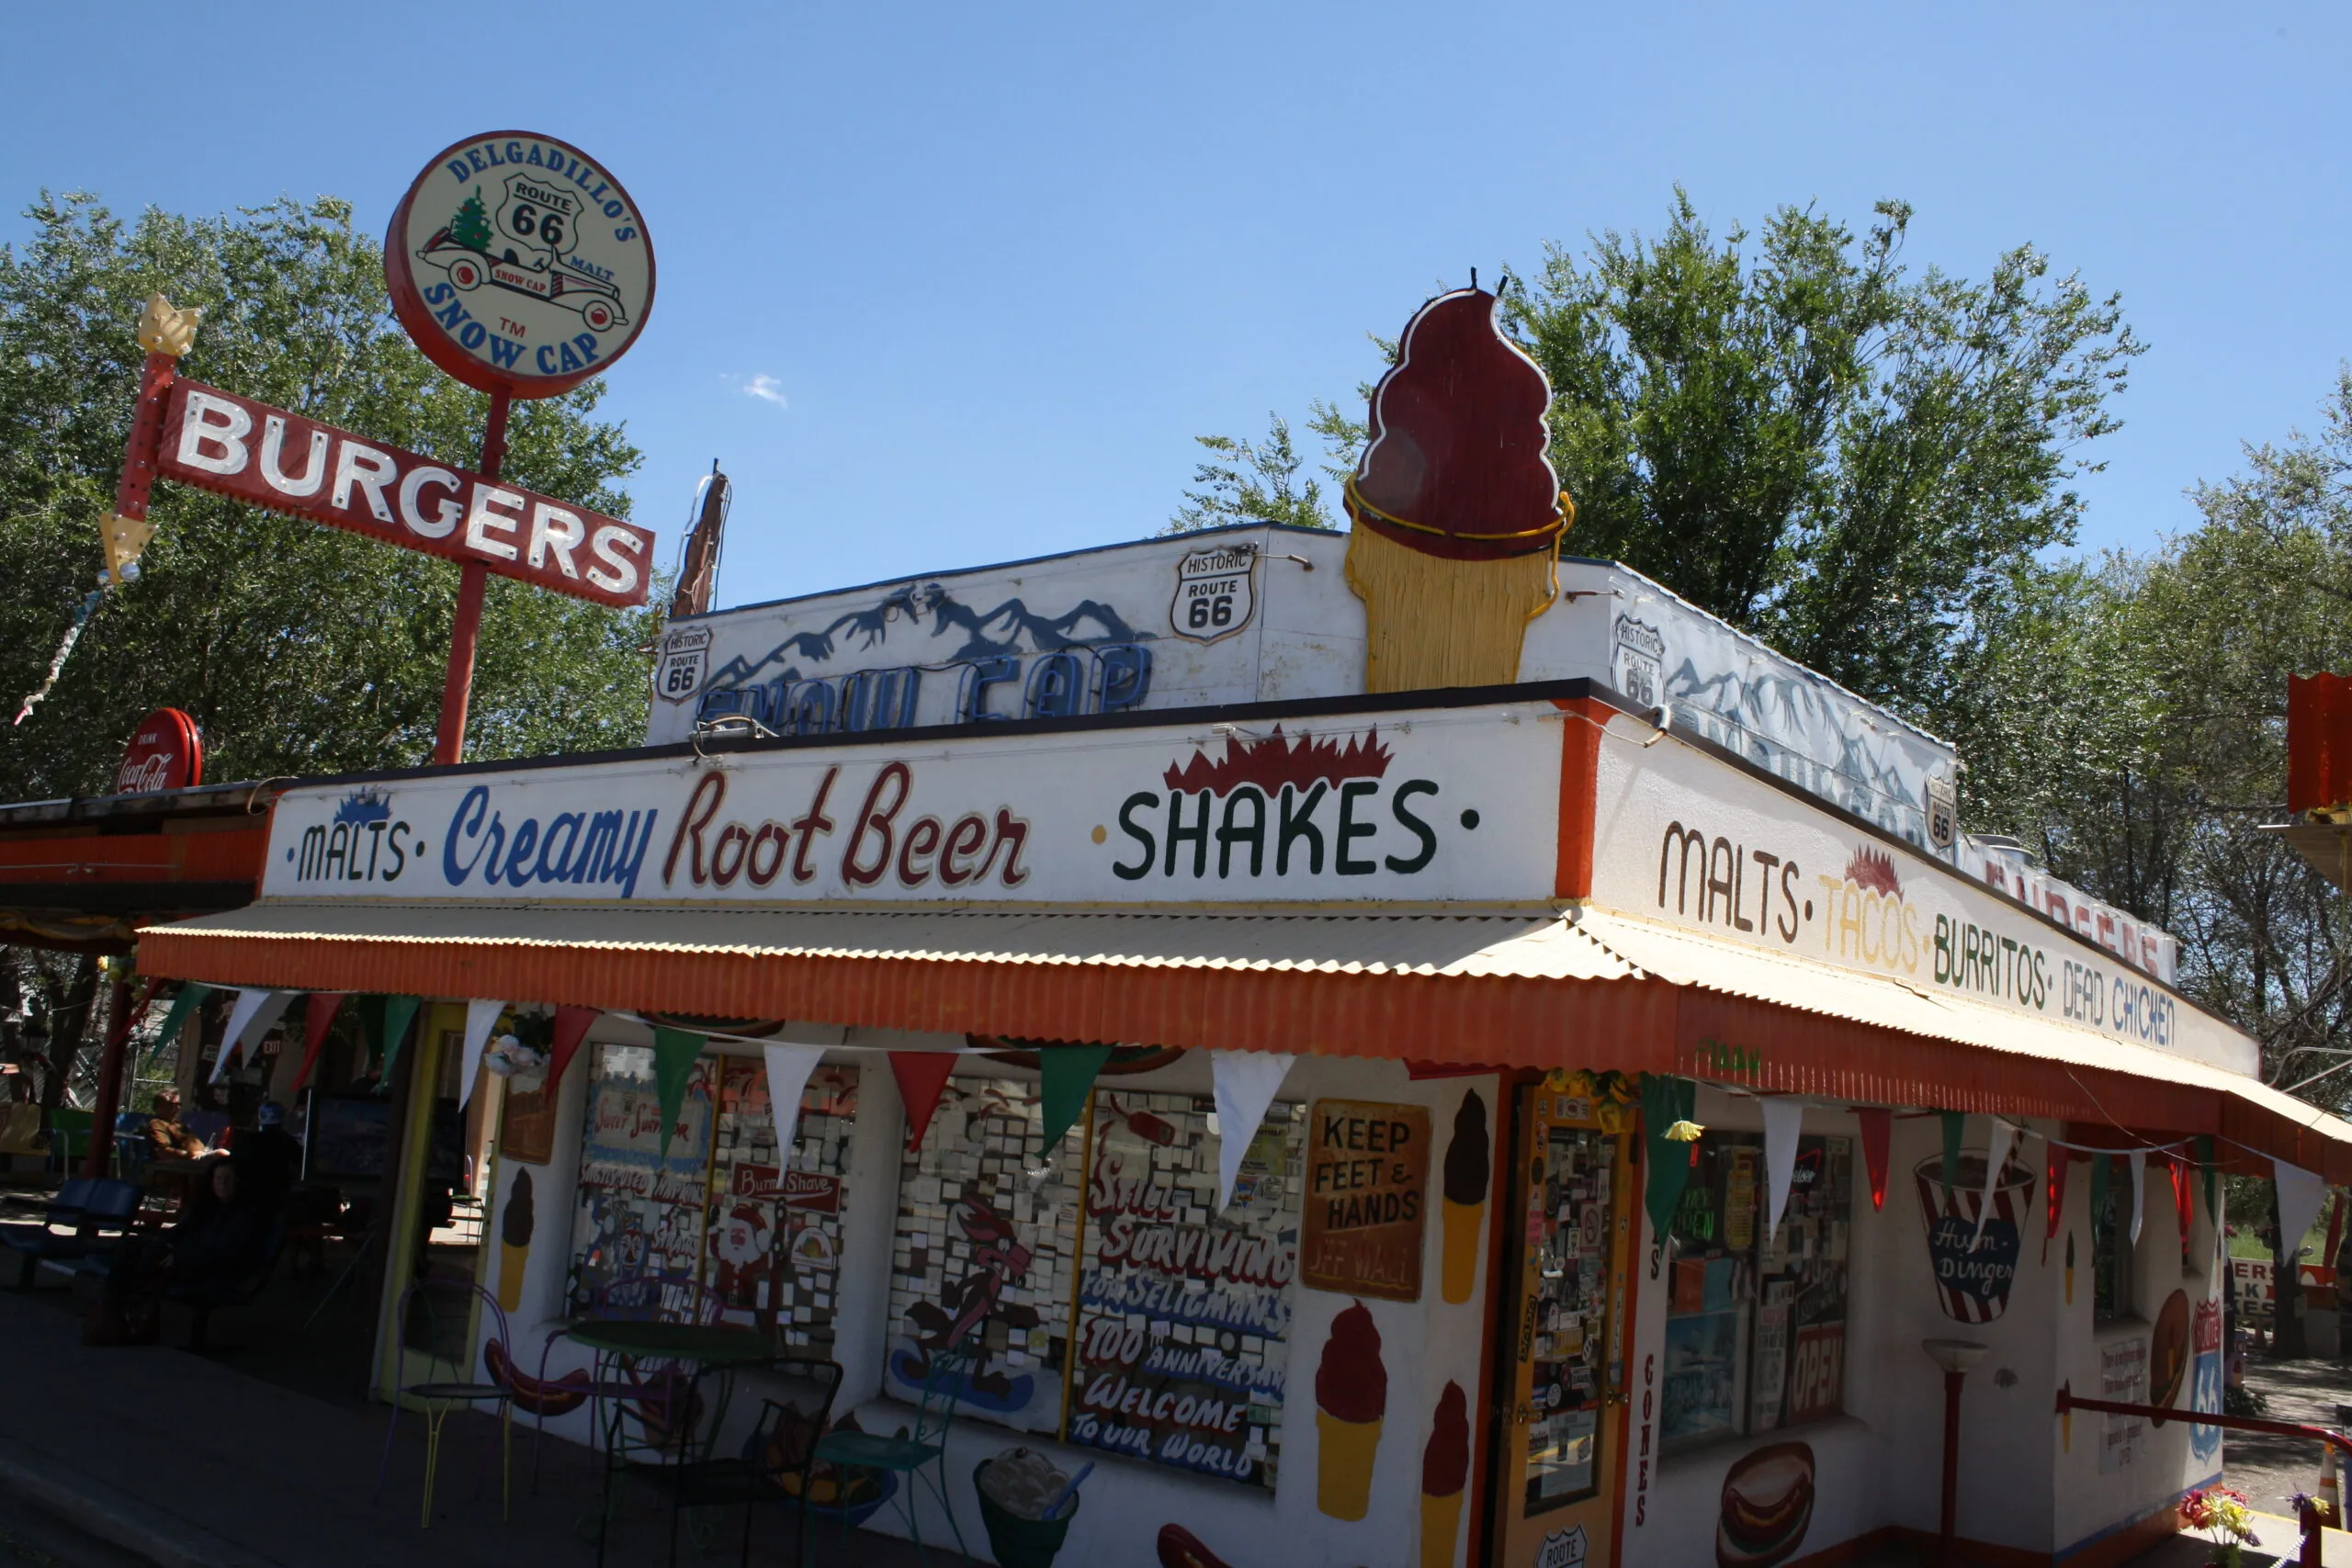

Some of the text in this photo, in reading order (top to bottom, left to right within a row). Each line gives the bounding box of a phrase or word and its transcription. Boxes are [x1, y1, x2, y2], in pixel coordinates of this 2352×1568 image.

[446, 141, 638, 243] DELGADILLO'S
[514, 180, 572, 212] ROUTE
[512, 203, 566, 246] 66
[493, 267, 547, 293] SNOW CAP
[568, 254, 616, 279] MALT
[423, 279, 601, 377] SNOW CAP
[499, 317, 526, 339] TM
[175, 389, 645, 595] BURGERS
[1186, 551, 1248, 576] HISTORIC
[1187, 580, 1238, 599] ROUTE
[1188, 597, 1233, 629] 66
[669, 632, 708, 651] HISTORIC
[1620, 623, 1659, 652] HISTORIC
[667, 665, 695, 692] 66
[669, 653, 701, 669] ROUTE
[1623, 651, 1655, 677] ROUTE
[954, 642, 1154, 724] CAP
[1625, 669, 1655, 707] 66
[297, 759, 1442, 899] MALTS Creamy Root Beer SHAKES
[1933, 813, 1950, 841] 66
[1657, 819, 2177, 1047] MALTS TACOS BURRITOS DEAD CHICKEN
[1323, 1114, 1411, 1154] KEEP
[1314, 1157, 1385, 1193] FEET
[1391, 1162, 1414, 1184] &
[1327, 1190, 1420, 1230] HANDS
[1099, 1218, 1296, 1290] SURVIVING
[1079, 1268, 1125, 1306] FOR
[1939, 1255, 2015, 1296] Dinger
[2196, 1314, 2220, 1348] ROUTE
[1082, 1316, 1146, 1369] 100
[1143, 1345, 1287, 1397] ANNIVERSAR
[1793, 1335, 1843, 1413] OPEN
[1080, 1372, 1248, 1433] WELCOME
[2195, 1365, 2218, 1438] 66
[1070, 1412, 1101, 1443] TO
[1160, 1433, 1253, 1480] WORLD
[1634, 1353, 1657, 1529] CONES
[1546, 1538, 1577, 1567] ROUTE
